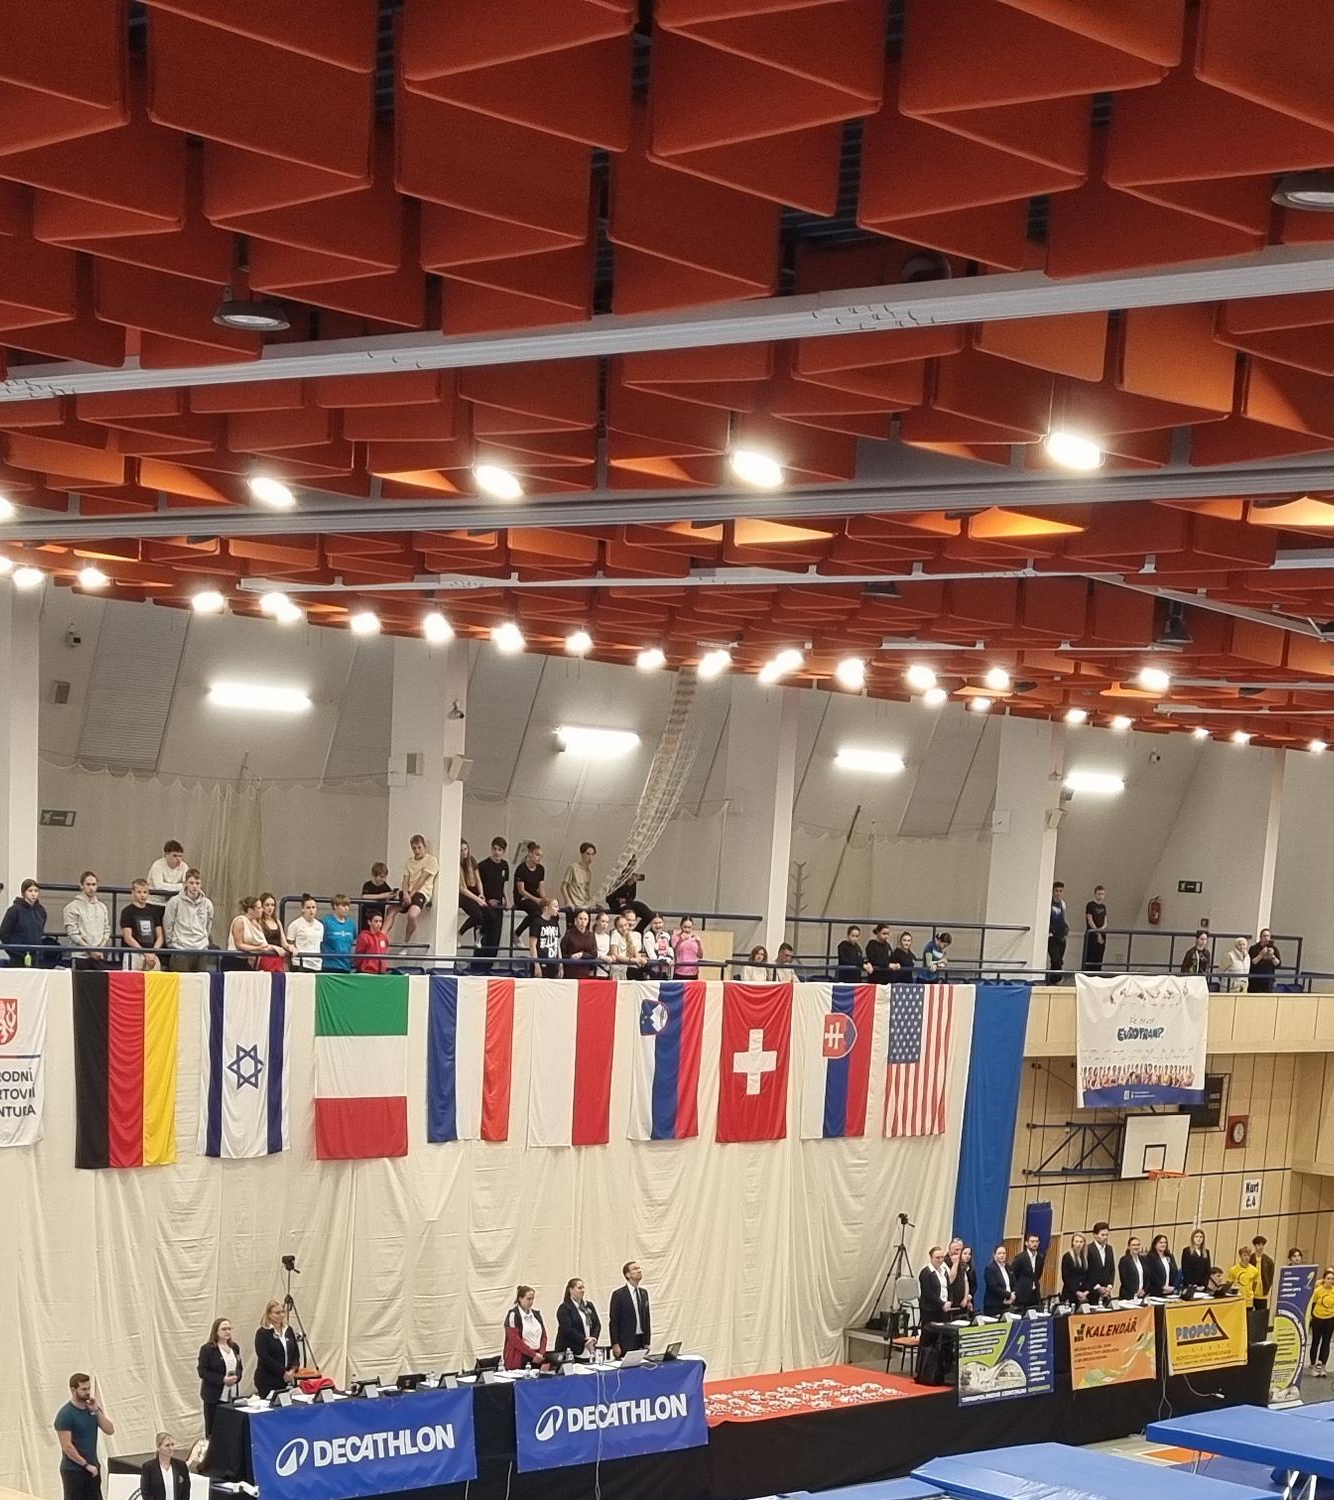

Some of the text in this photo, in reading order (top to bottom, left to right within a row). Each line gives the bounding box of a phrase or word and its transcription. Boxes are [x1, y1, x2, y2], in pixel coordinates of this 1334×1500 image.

[1085, 1316, 1138, 1339] KALENDÁŘ
[567, 1393, 688, 1434] DECATHLON
[313, 1423, 456, 1468] DECATHLON
